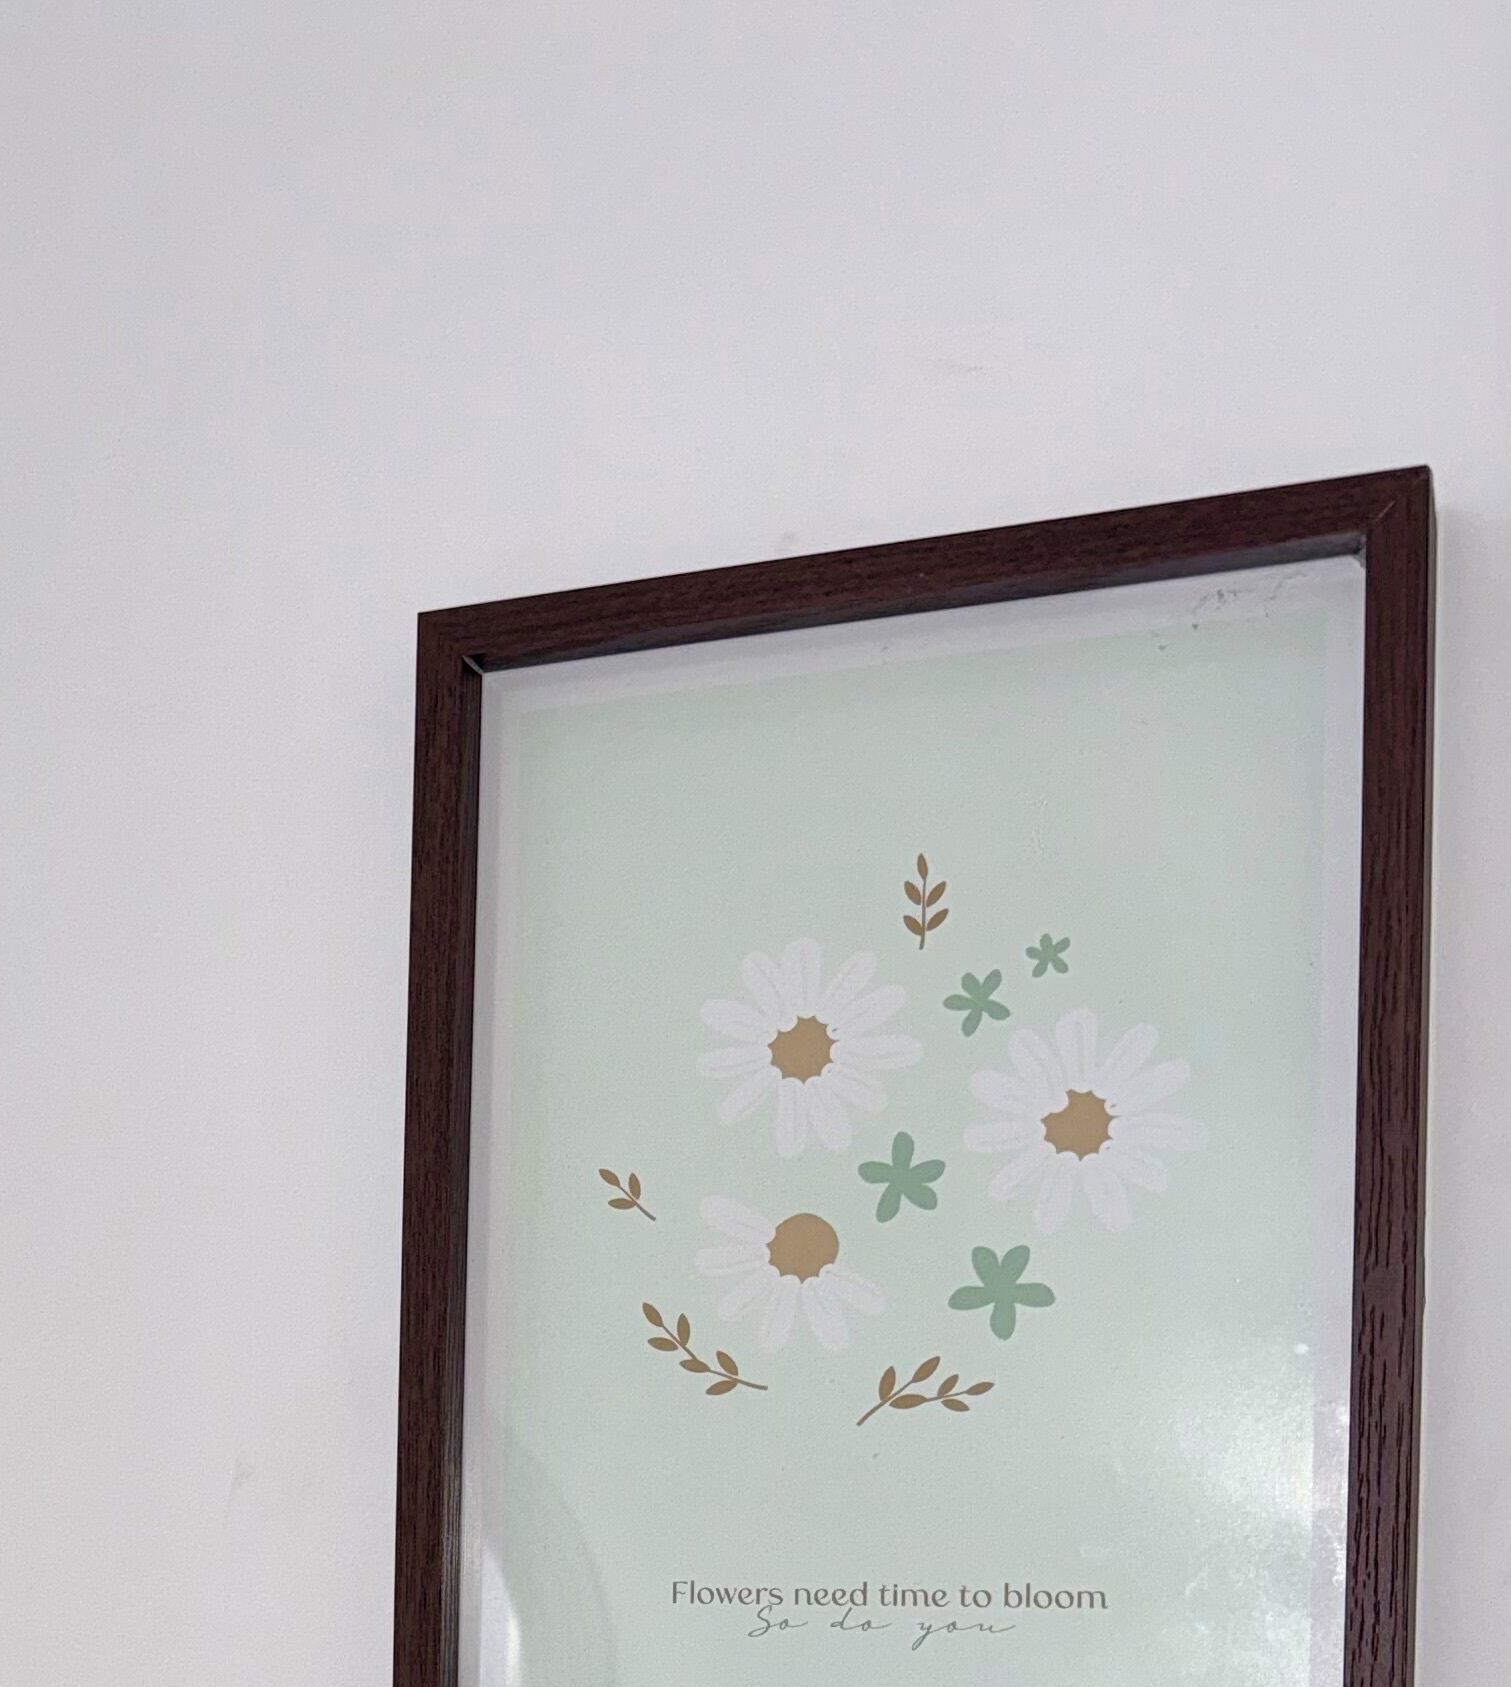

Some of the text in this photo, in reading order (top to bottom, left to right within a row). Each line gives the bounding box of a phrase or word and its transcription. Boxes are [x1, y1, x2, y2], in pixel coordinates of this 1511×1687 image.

[671, 1579, 1108, 1609] Flowers need time to bloom
[747, 1604, 1017, 1651] So do you
